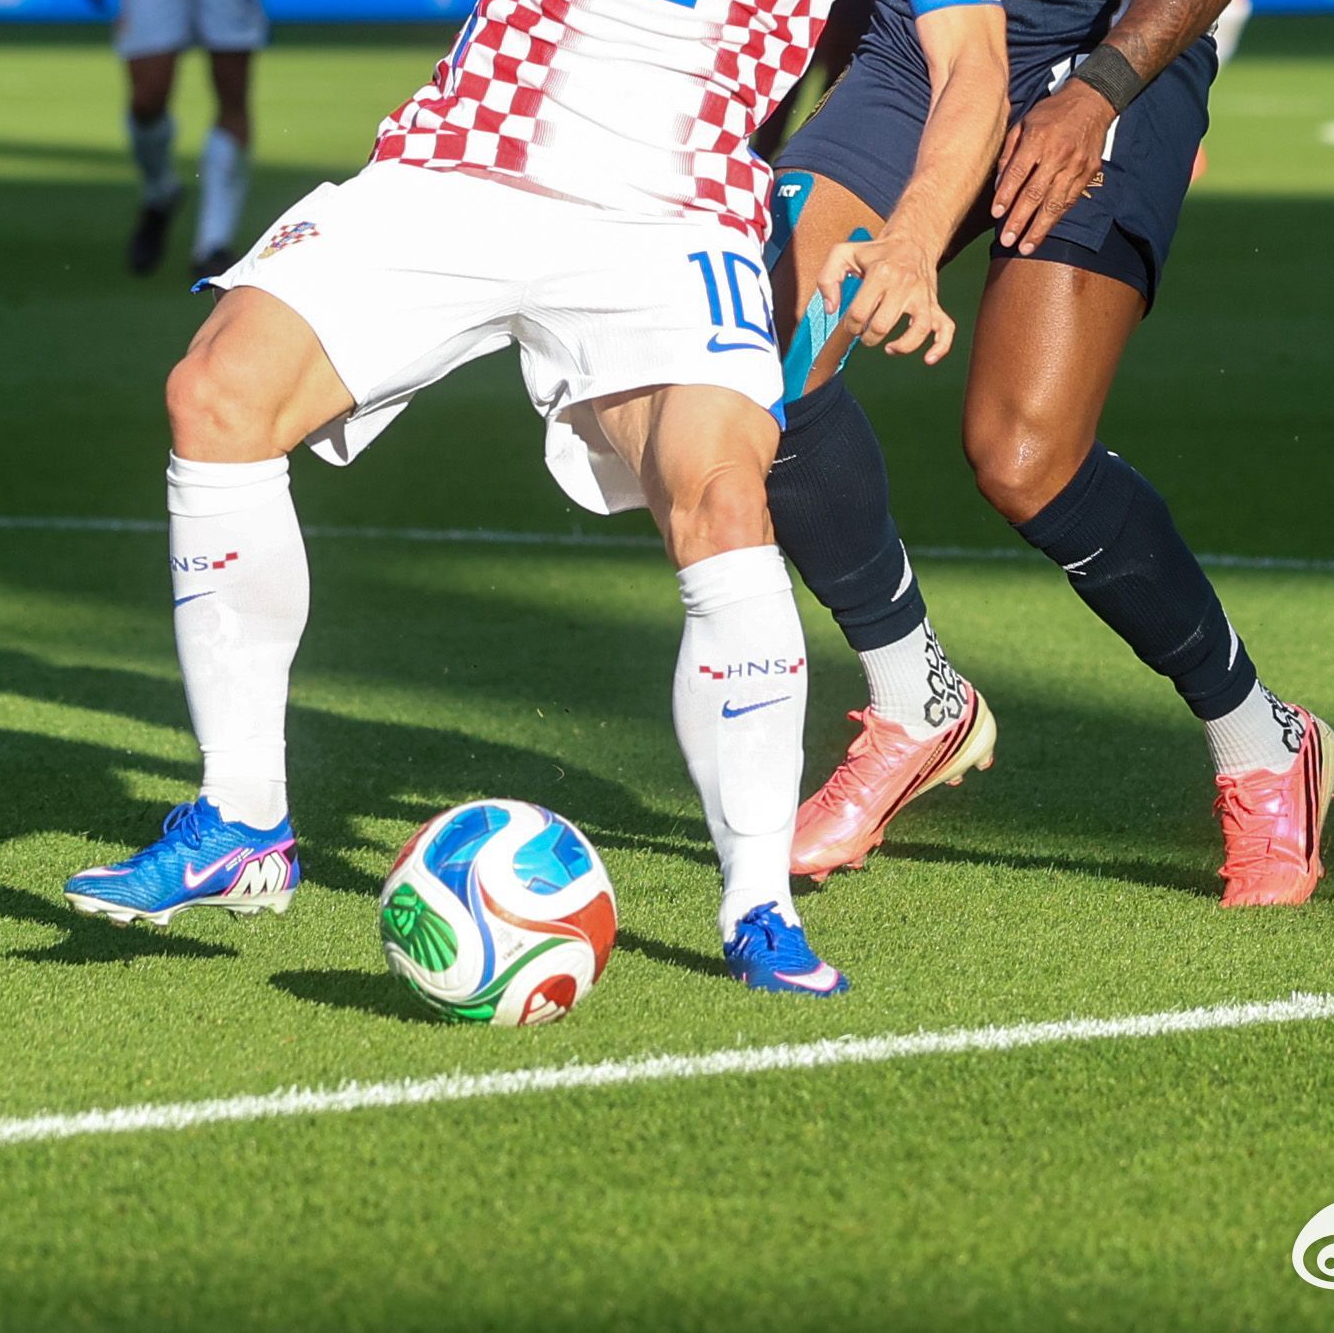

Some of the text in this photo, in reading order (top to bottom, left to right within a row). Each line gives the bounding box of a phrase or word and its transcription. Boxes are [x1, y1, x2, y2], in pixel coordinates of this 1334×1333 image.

[687, 250, 776, 346] 10
[170, 554, 209, 572] NS
[727, 659, 787, 679] HNS
